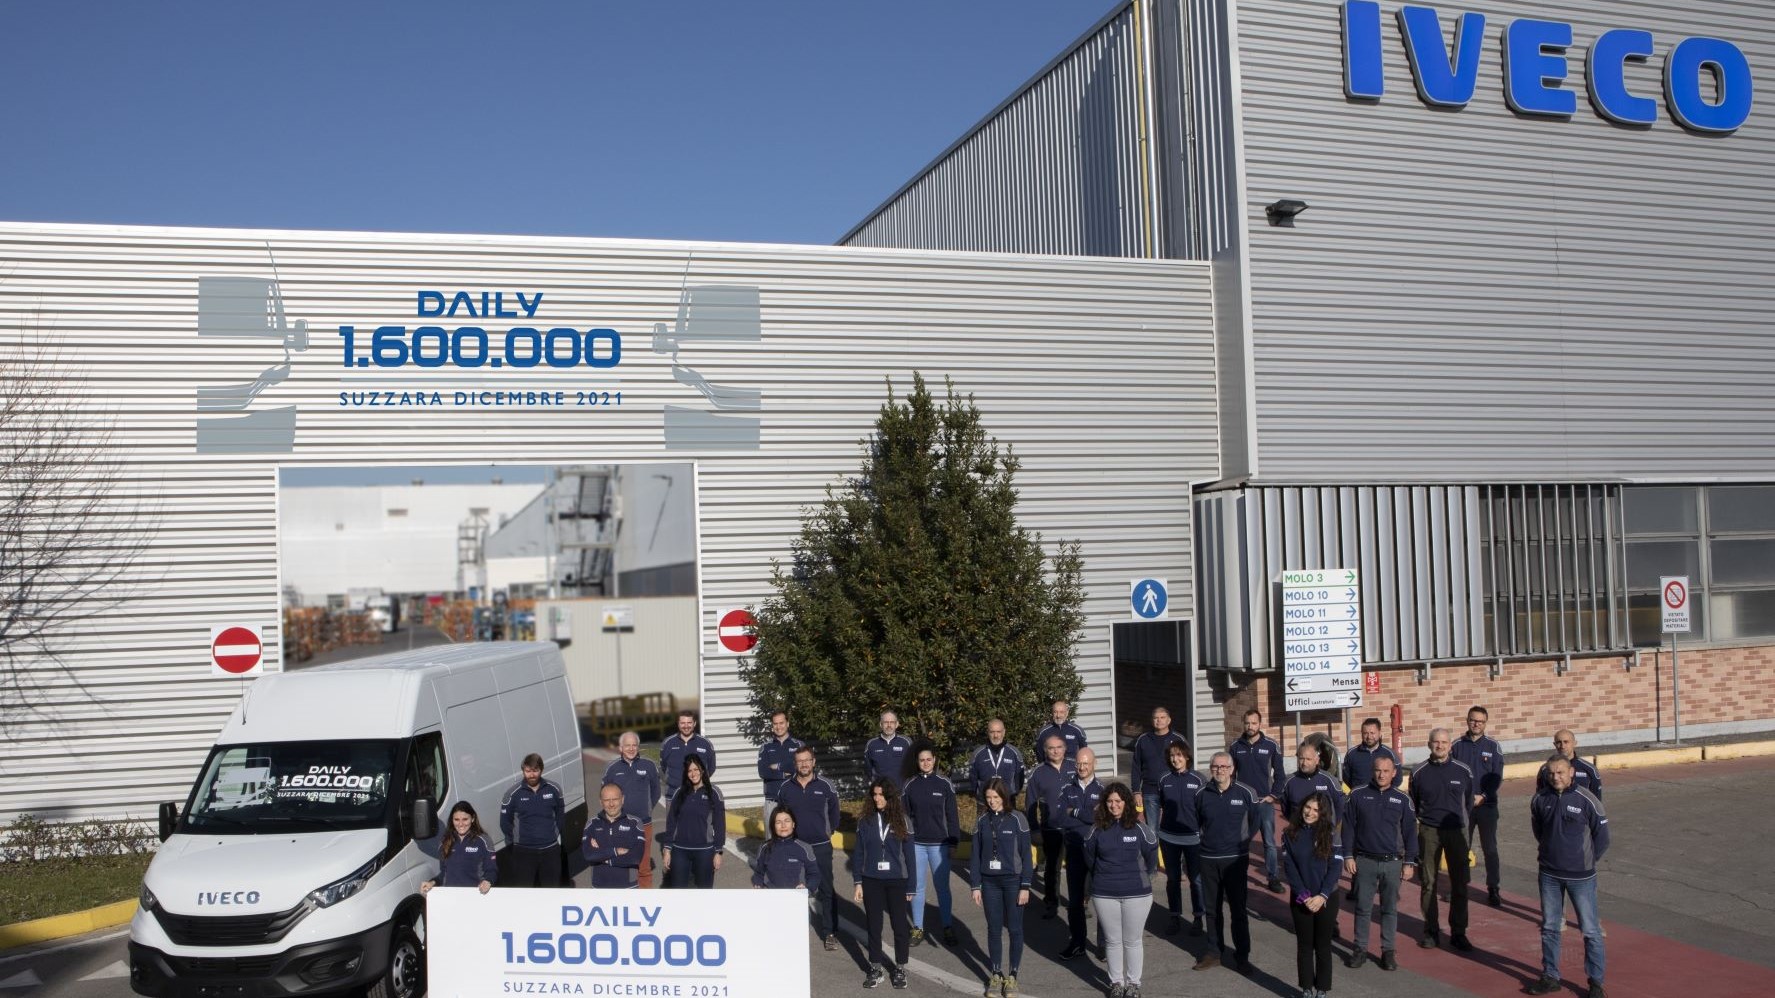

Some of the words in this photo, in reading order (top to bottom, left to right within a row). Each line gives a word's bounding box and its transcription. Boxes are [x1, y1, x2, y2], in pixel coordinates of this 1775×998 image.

[1340, 0, 1753, 132] IVECO
[417, 290, 544, 319] DAILY
[338, 325, 622, 369] 1.600.000
[339, 391, 443, 406] SUZZARA
[454, 391, 565, 406] DICEMBRE
[576, 391, 622, 406] 2021
[1285, 574, 1314, 584] MOLO
[1317, 574, 1323, 582] 3
[1286, 591, 1314, 600] MOLO
[1318, 590, 1328, 600] 10
[1286, 608, 1314, 618] MOLO
[1318, 608, 1326, 618] 11
[1286, 626, 1315, 636] MOLO
[1318, 626, 1328, 634] 12
[1286, 644, 1316, 654] MOLO
[1319, 644, 1330, 652] 13
[1287, 662, 1316, 672] MOLO
[1320, 660, 1330, 670] 14
[1332, 678, 1360, 686] Mensa
[1288, 698, 1310, 706] Uffici
[308, 766, 352, 774] DAILY
[280, 774, 374, 788] 1.600.000
[198, 891, 260, 905] IVECO
[561, 905, 662, 927] DAILY
[501, 931, 727, 967] 1.600.000
[504, 981, 584, 994] SUZZARA
[593, 983, 681, 996] DICEMBRE
[691, 985, 728, 997] 2021
